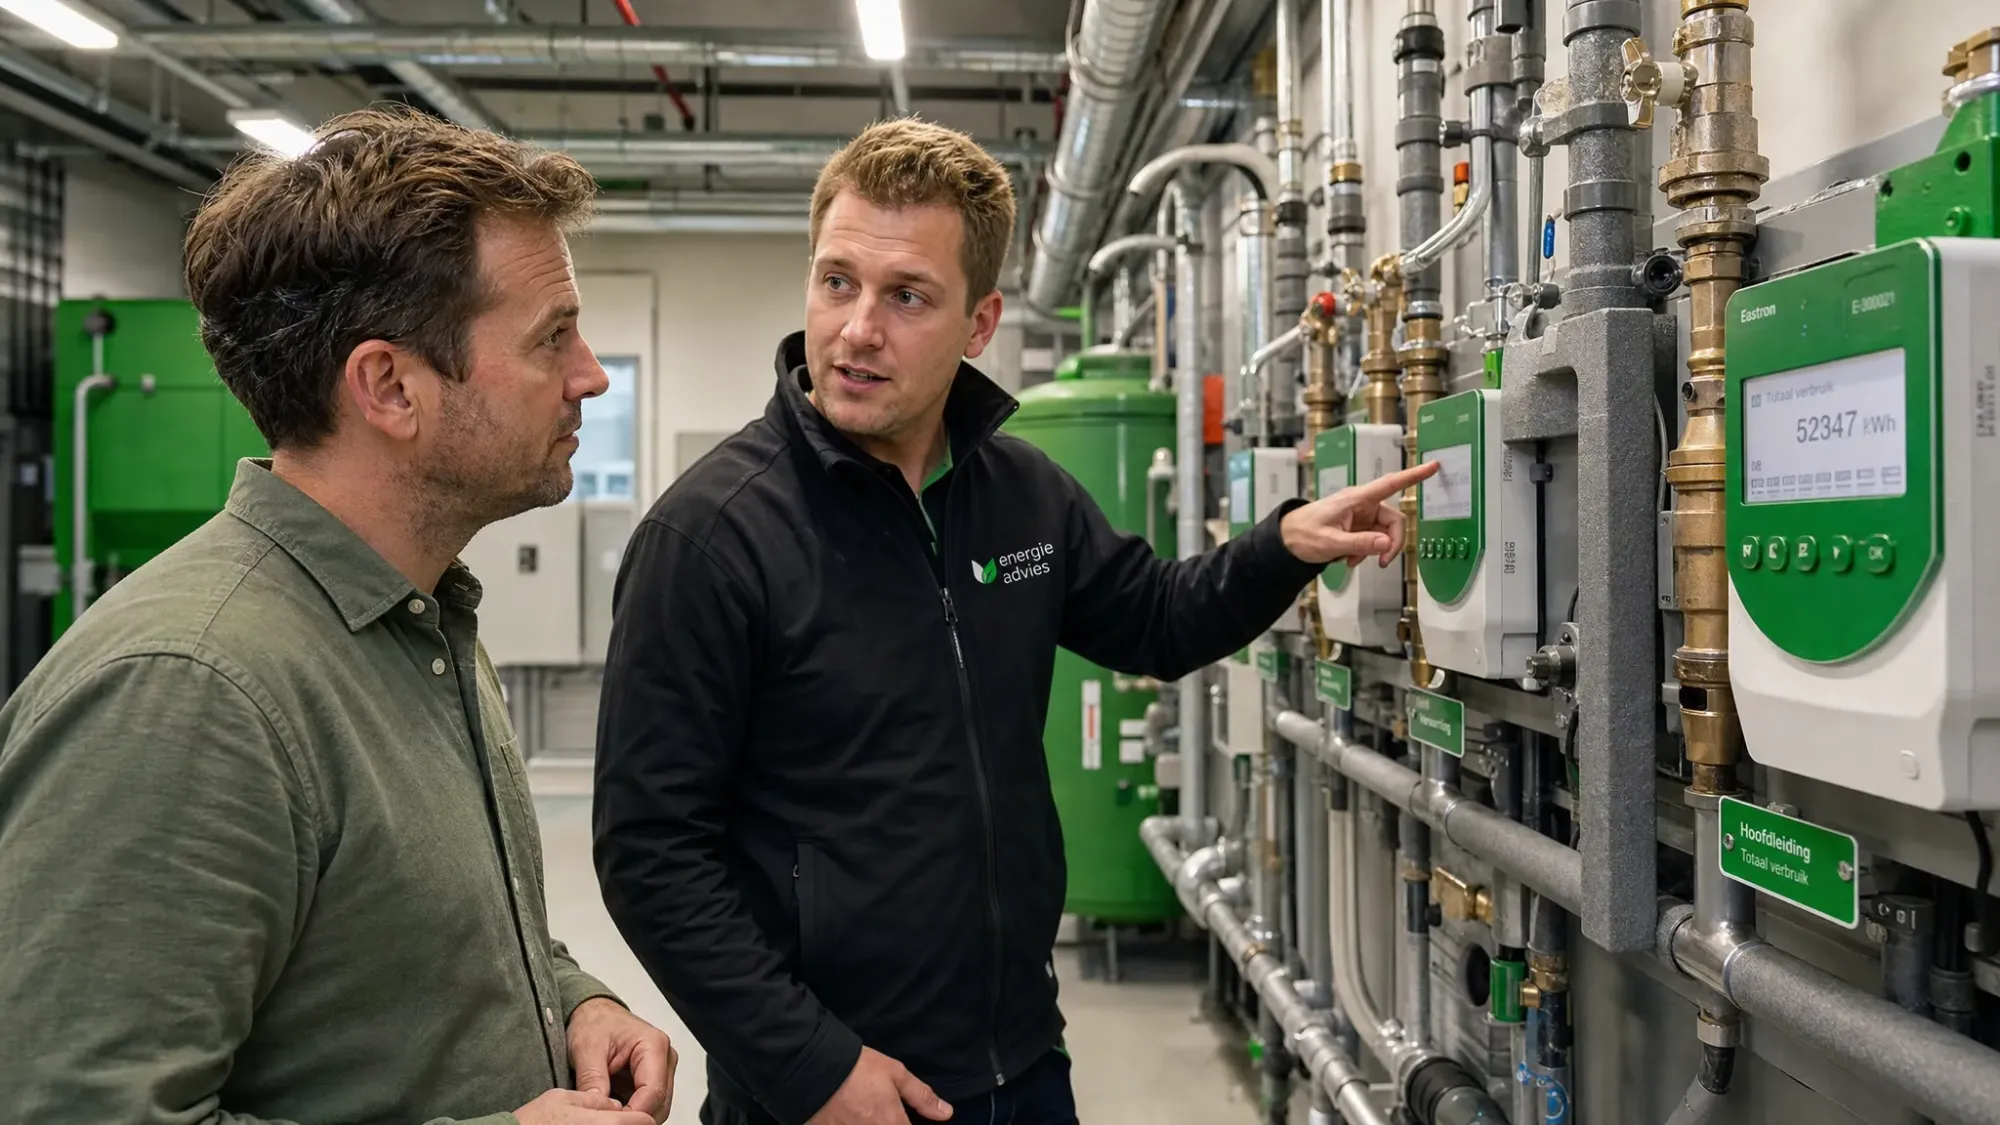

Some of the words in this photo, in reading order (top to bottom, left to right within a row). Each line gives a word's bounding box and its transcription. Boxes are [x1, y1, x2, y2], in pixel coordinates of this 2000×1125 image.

[1741, 304, 1776, 323] Eastron
[1765, 387, 1794, 403] Totaal
[1796, 410, 1858, 443] 52347
[1863, 414, 1896, 436] kWh
[999, 542, 1053, 567] energie
[1003, 562, 1050, 584] advies
[1740, 821, 1811, 864] Hoofdleiding
[1740, 848, 1769, 871] Totaal
[1770, 860, 1809, 886] verbruik
